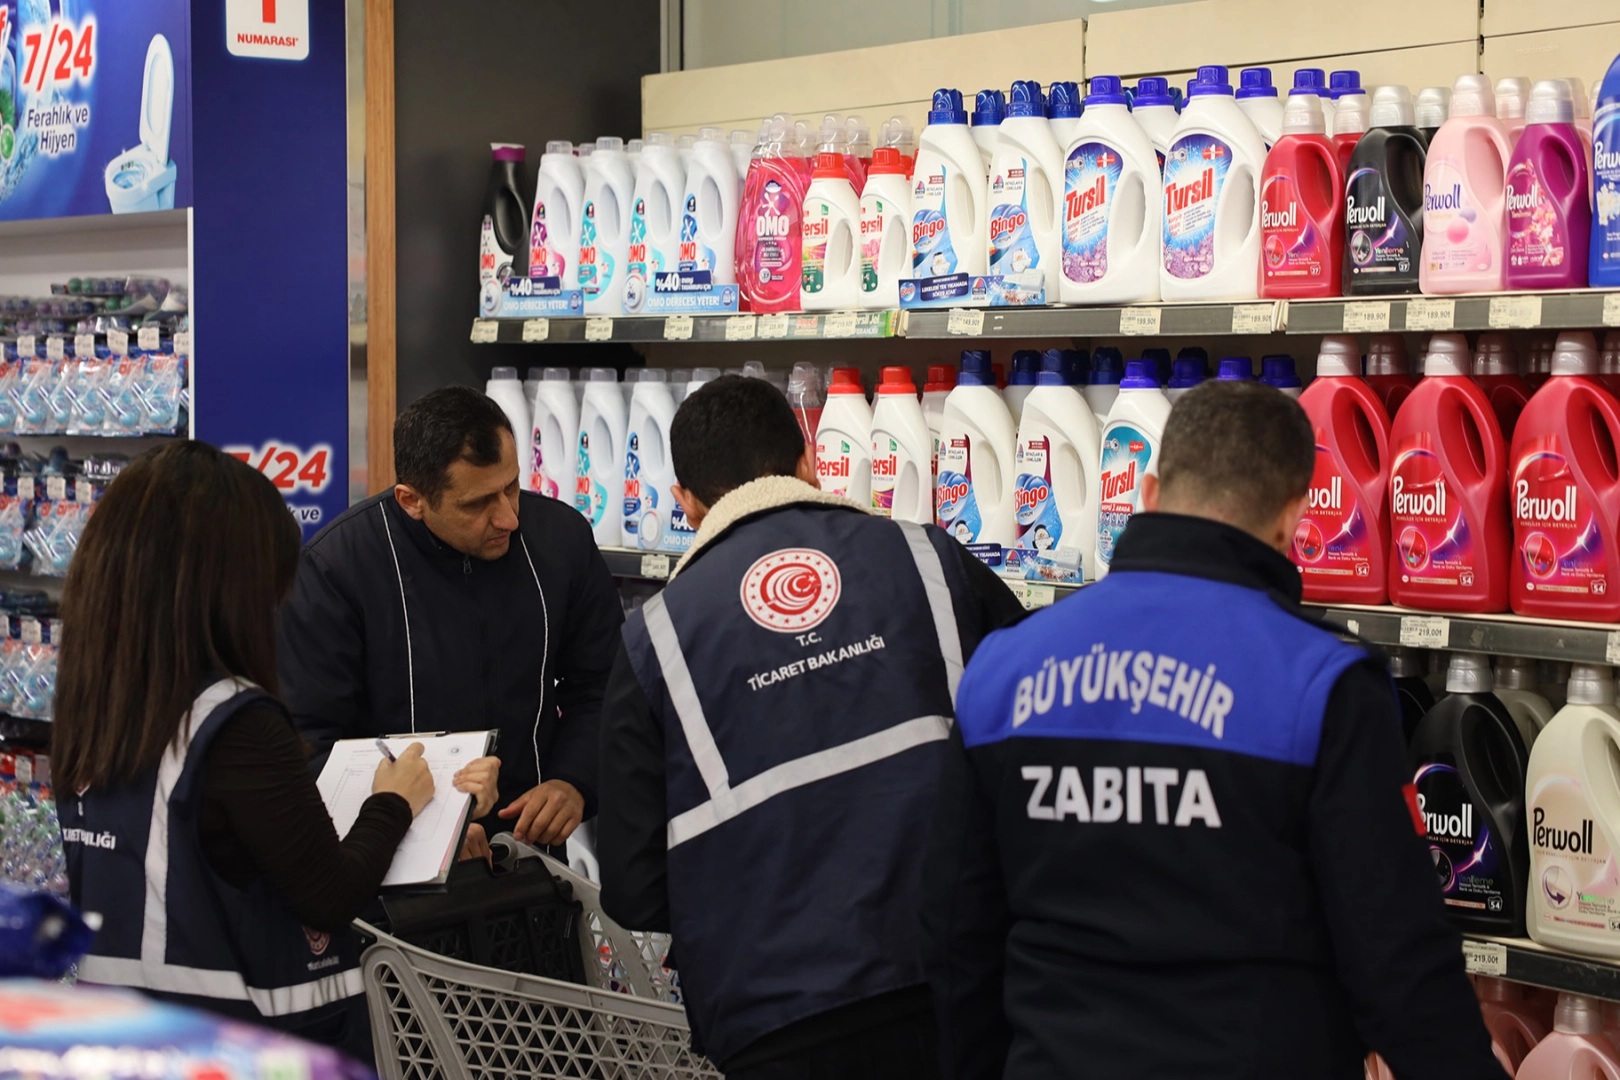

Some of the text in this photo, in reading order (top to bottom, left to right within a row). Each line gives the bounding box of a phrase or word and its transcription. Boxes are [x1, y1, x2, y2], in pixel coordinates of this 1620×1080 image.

[22, 25, 94, 92] 7/24
[27, 106, 88, 128] Ferahlık ve
[40, 131, 75, 153] Hijyen
[1066, 175, 1105, 222] Tursil
[1165, 168, 1213, 216] Tursil
[1424, 183, 1461, 211] Perwoll
[1506, 184, 1538, 211] Perwoll
[1262, 201, 1296, 228] Perwoll
[1347, 195, 1385, 224] Perwoll
[756, 215, 790, 237] OMO
[860, 215, 882, 233] ersil
[913, 218, 945, 244] Bingo
[991, 213, 1025, 240] Bingo
[510, 279, 532, 296] %40
[656, 273, 680, 291] %40
[872, 454, 897, 476] ersil
[1101, 461, 1136, 501] Tursil
[1309, 476, 1342, 509] woll
[938, 483, 968, 508] Bingo
[1015, 486, 1047, 512] Bingo
[1393, 476, 1446, 516] Perwoll
[1516, 479, 1577, 521] Perwoll
[301, 507, 320, 521] ve
[672, 513, 694, 530] %4
[1593, 584, 1604, 592] 54
[796, 633, 822, 646] T.C.
[747, 634, 885, 691] TİCARET BAKANLIĞI
[1012, 642, 1234, 740] BÜYÜKŞEHİR
[1021, 766, 1222, 828] ZABITA
[1533, 807, 1593, 854] Perwoll
[1490, 902, 1500, 910] 54
